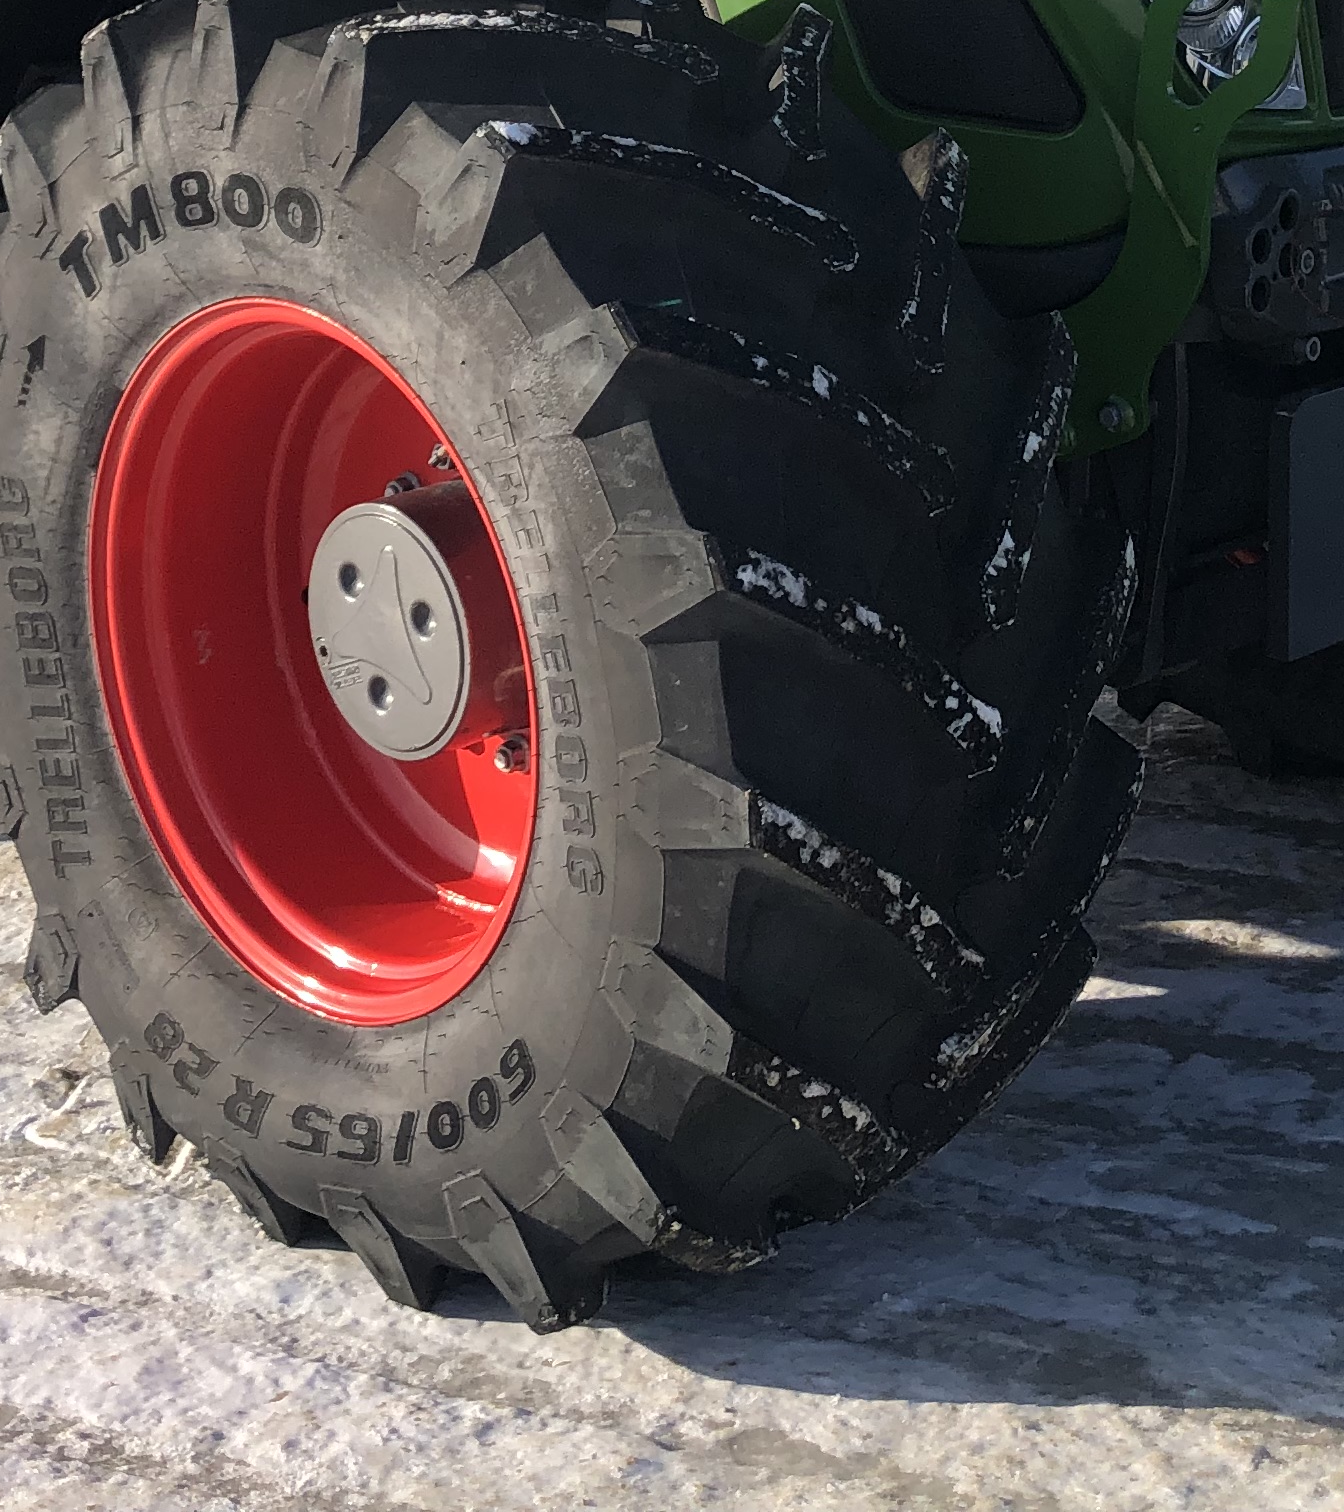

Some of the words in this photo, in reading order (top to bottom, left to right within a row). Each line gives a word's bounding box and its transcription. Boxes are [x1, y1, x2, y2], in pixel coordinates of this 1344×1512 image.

[473, 398, 604, 896] TRELLEBORG
[143, 1010, 221, 1097] 28
[223, 1075, 274, 1138] R
[286, 1038, 537, 1166] 600/65
